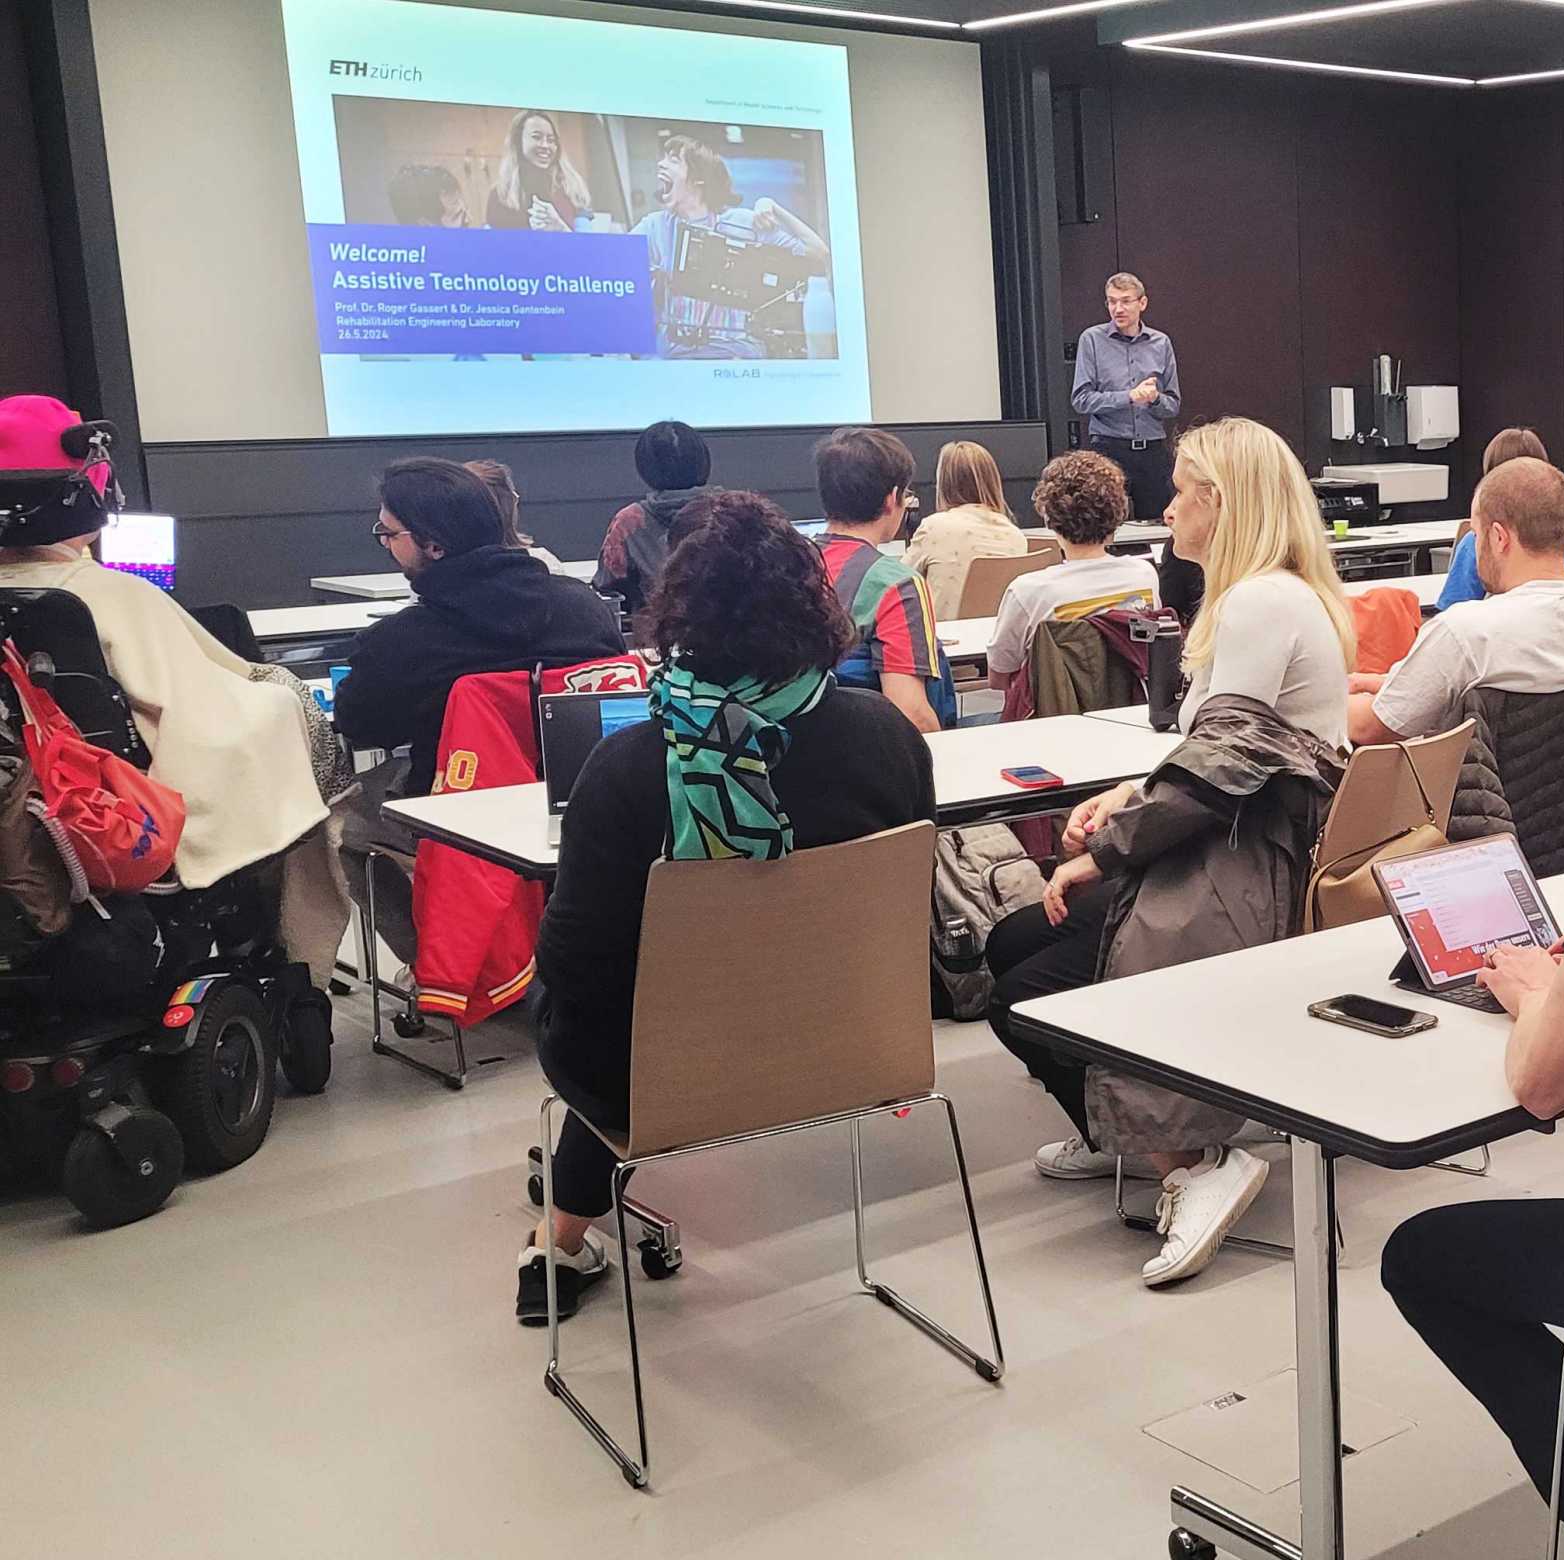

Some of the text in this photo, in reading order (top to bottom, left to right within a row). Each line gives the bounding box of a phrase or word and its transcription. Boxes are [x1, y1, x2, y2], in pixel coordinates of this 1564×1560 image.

[329, 60, 422, 81] ETH zürich
[330, 242, 426, 263] Welcome!
[332, 270, 635, 297] Assistive Technology Challenge
[335, 302, 360, 313] Prof.
[361, 302, 376, 313] Dr.
[378, 302, 407, 315] Roger
[410, 303, 448, 313] Gassert
[450, 304, 457, 313] &
[460, 304, 473, 313] Dr.
[476, 304, 510, 314] Jessica
[336, 316, 520, 328] Rehabilitation Engineering Laboratory
[338, 329, 389, 340] 26.5.2024
